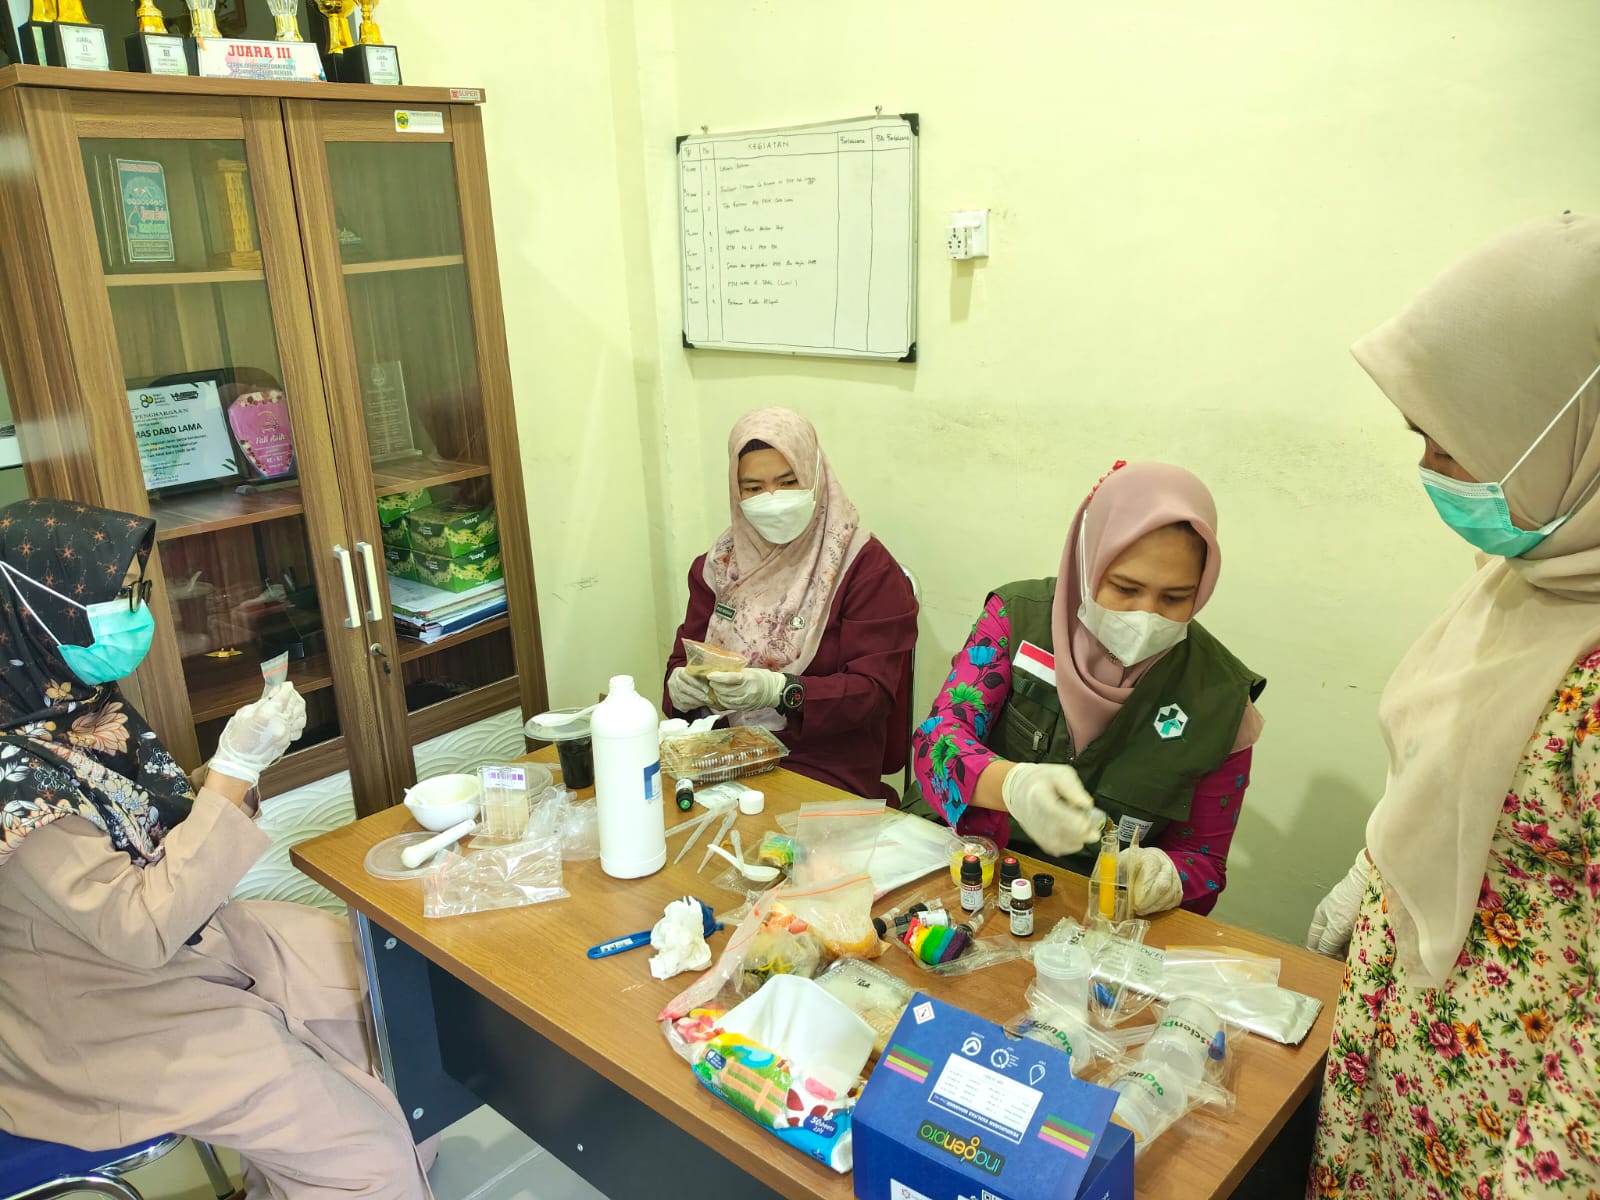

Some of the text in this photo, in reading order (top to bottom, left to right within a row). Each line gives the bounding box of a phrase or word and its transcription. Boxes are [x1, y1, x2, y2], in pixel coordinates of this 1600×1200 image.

[227, 44, 292, 59] JUARA III
[748, 141, 790, 151] KEGIATAN
[134, 408, 189, 420] PENGHARGAAN
[152, 426, 177, 437] DABO
[178, 422, 203, 433] LAMA
